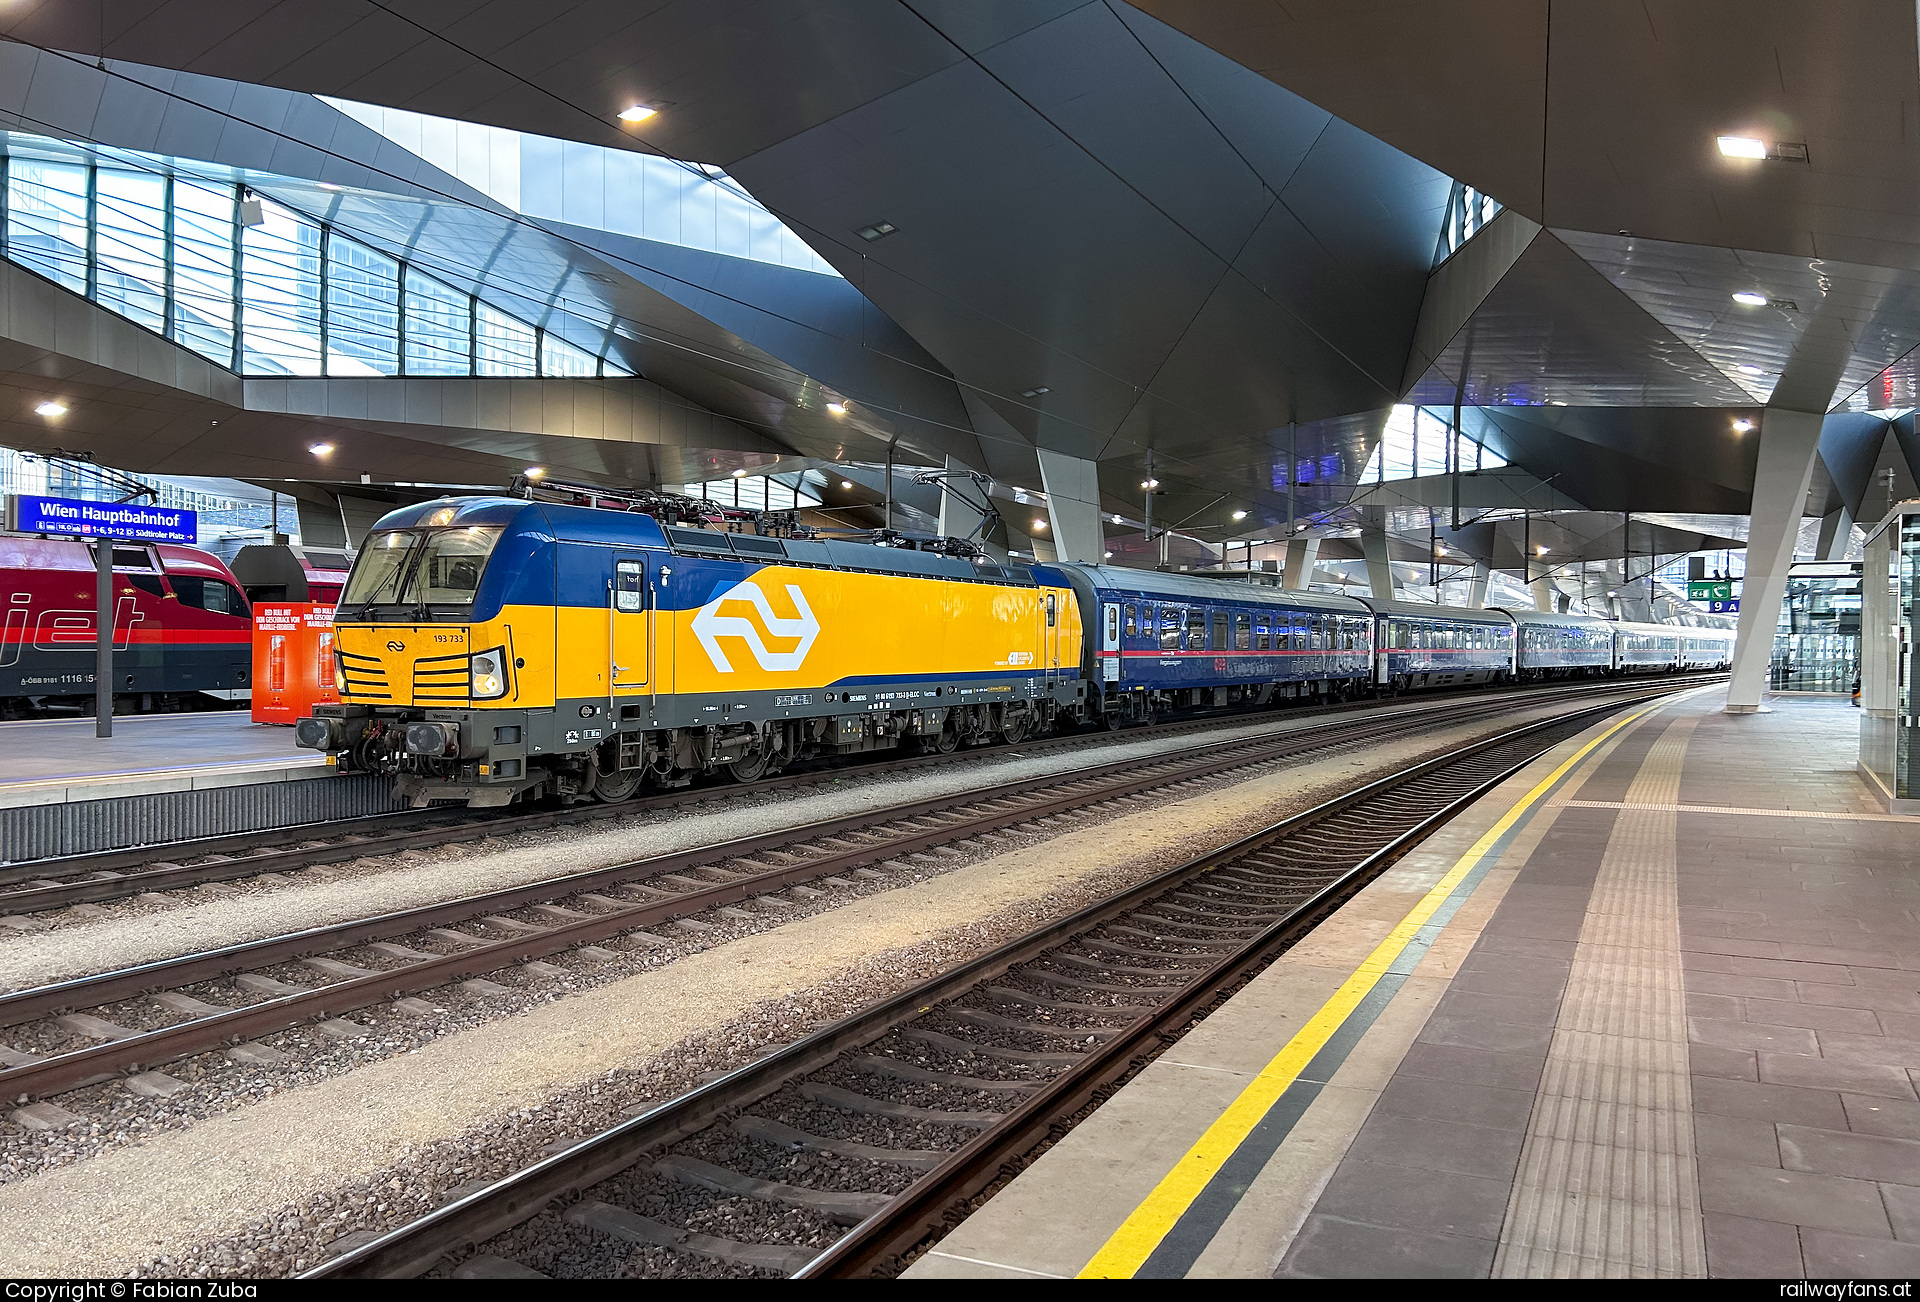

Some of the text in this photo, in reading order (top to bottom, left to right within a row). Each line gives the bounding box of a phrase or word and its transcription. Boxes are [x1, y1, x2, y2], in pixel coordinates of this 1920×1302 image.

[40, 502, 179, 527] Wien Hauptbahnhof
[107, 527, 124, 536] 9-12
[135, 528, 168, 539] Südtiroler
[168, 532, 185, 540] Platz
[1714, 601, 1737, 612] 9 A
[433, 635, 464, 643] 193 733
[60, 674, 82, 683] 1116
